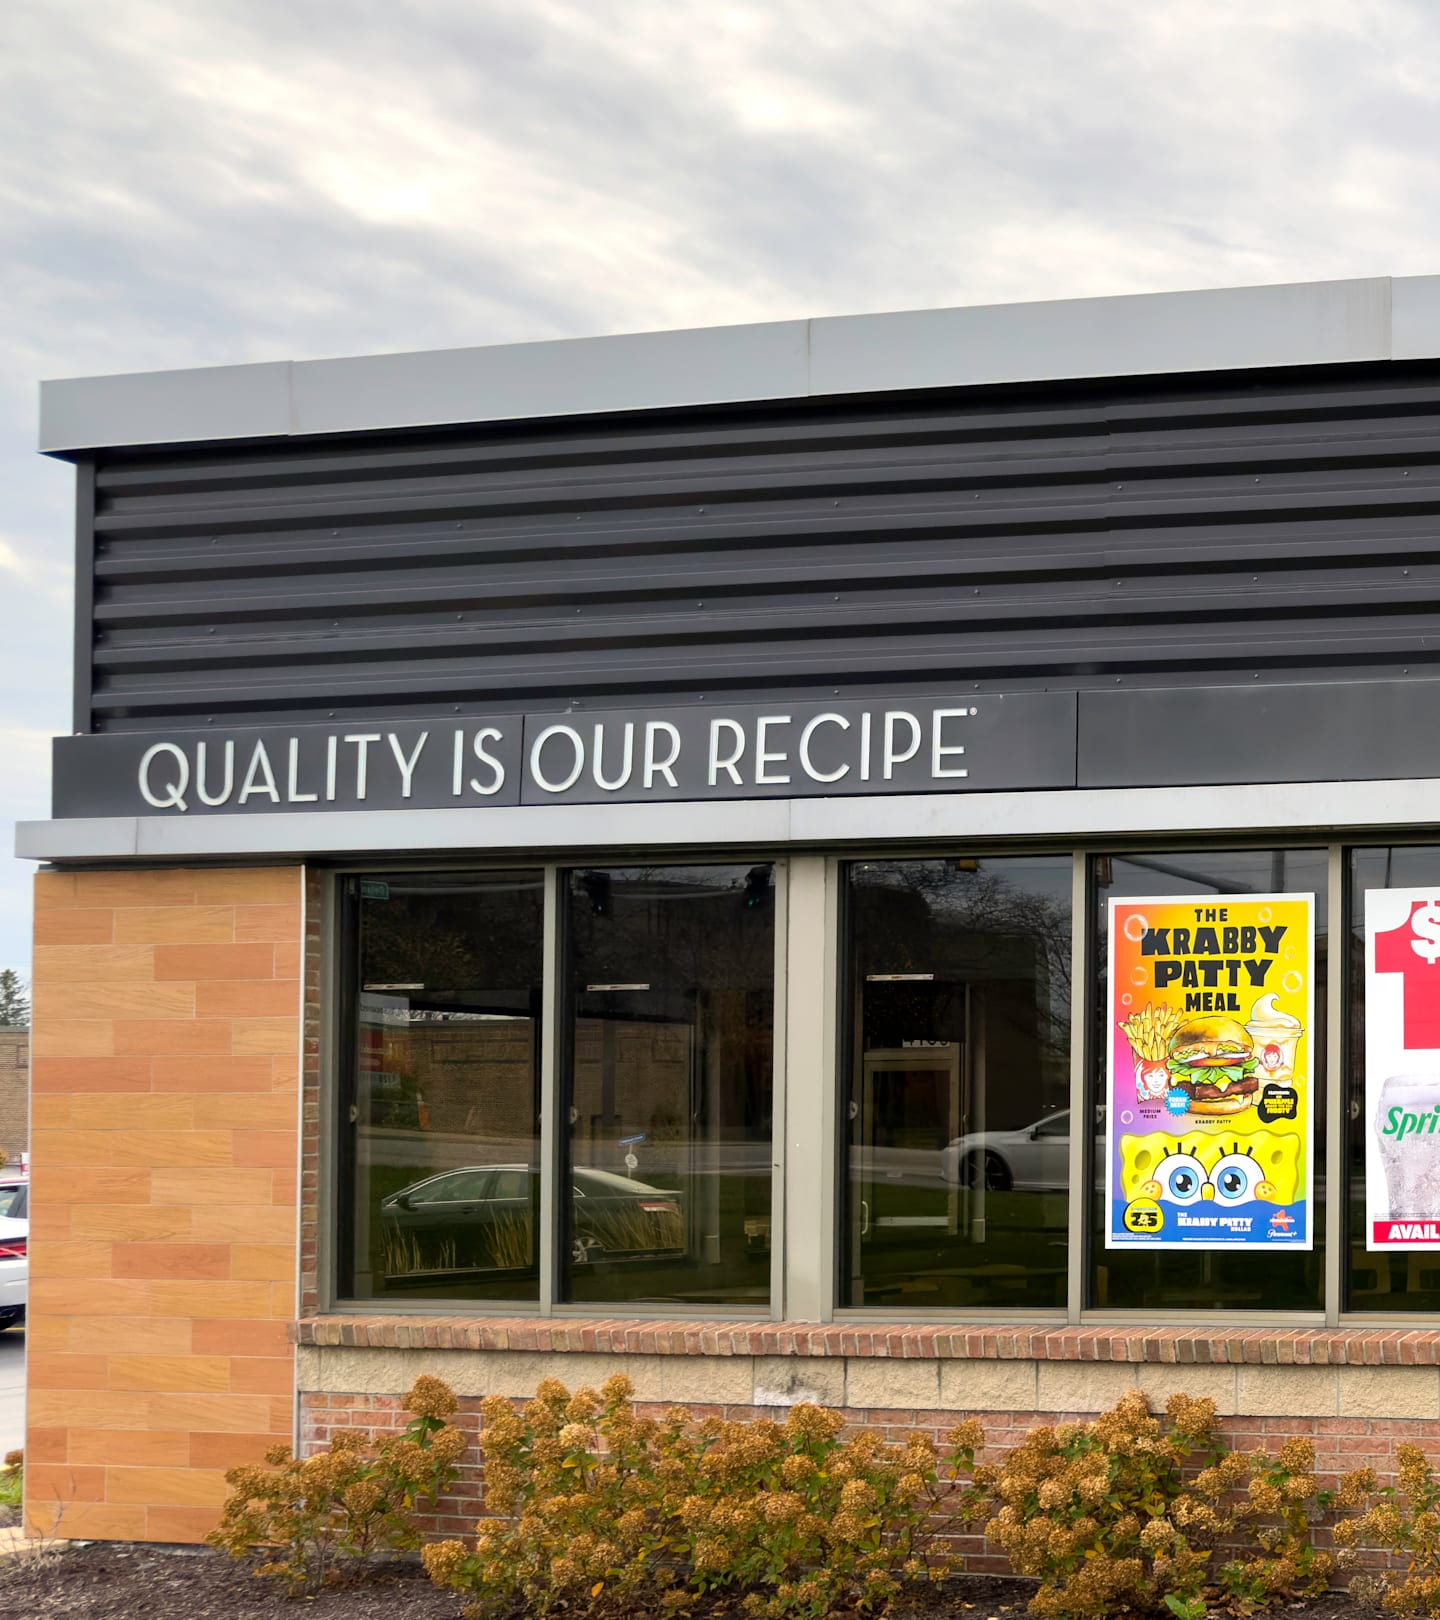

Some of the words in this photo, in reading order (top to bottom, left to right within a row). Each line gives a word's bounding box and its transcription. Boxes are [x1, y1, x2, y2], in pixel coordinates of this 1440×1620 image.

[138, 731, 429, 812] QUALITY
[452, 727, 505, 796] IS
[530, 720, 681, 793] OUR
[1194, 908, 1228, 922] THE
[1141, 926, 1288, 956] KRABBY
[1154, 959, 1273, 988] PATTY
[1185, 992, 1240, 1012] MEAL
